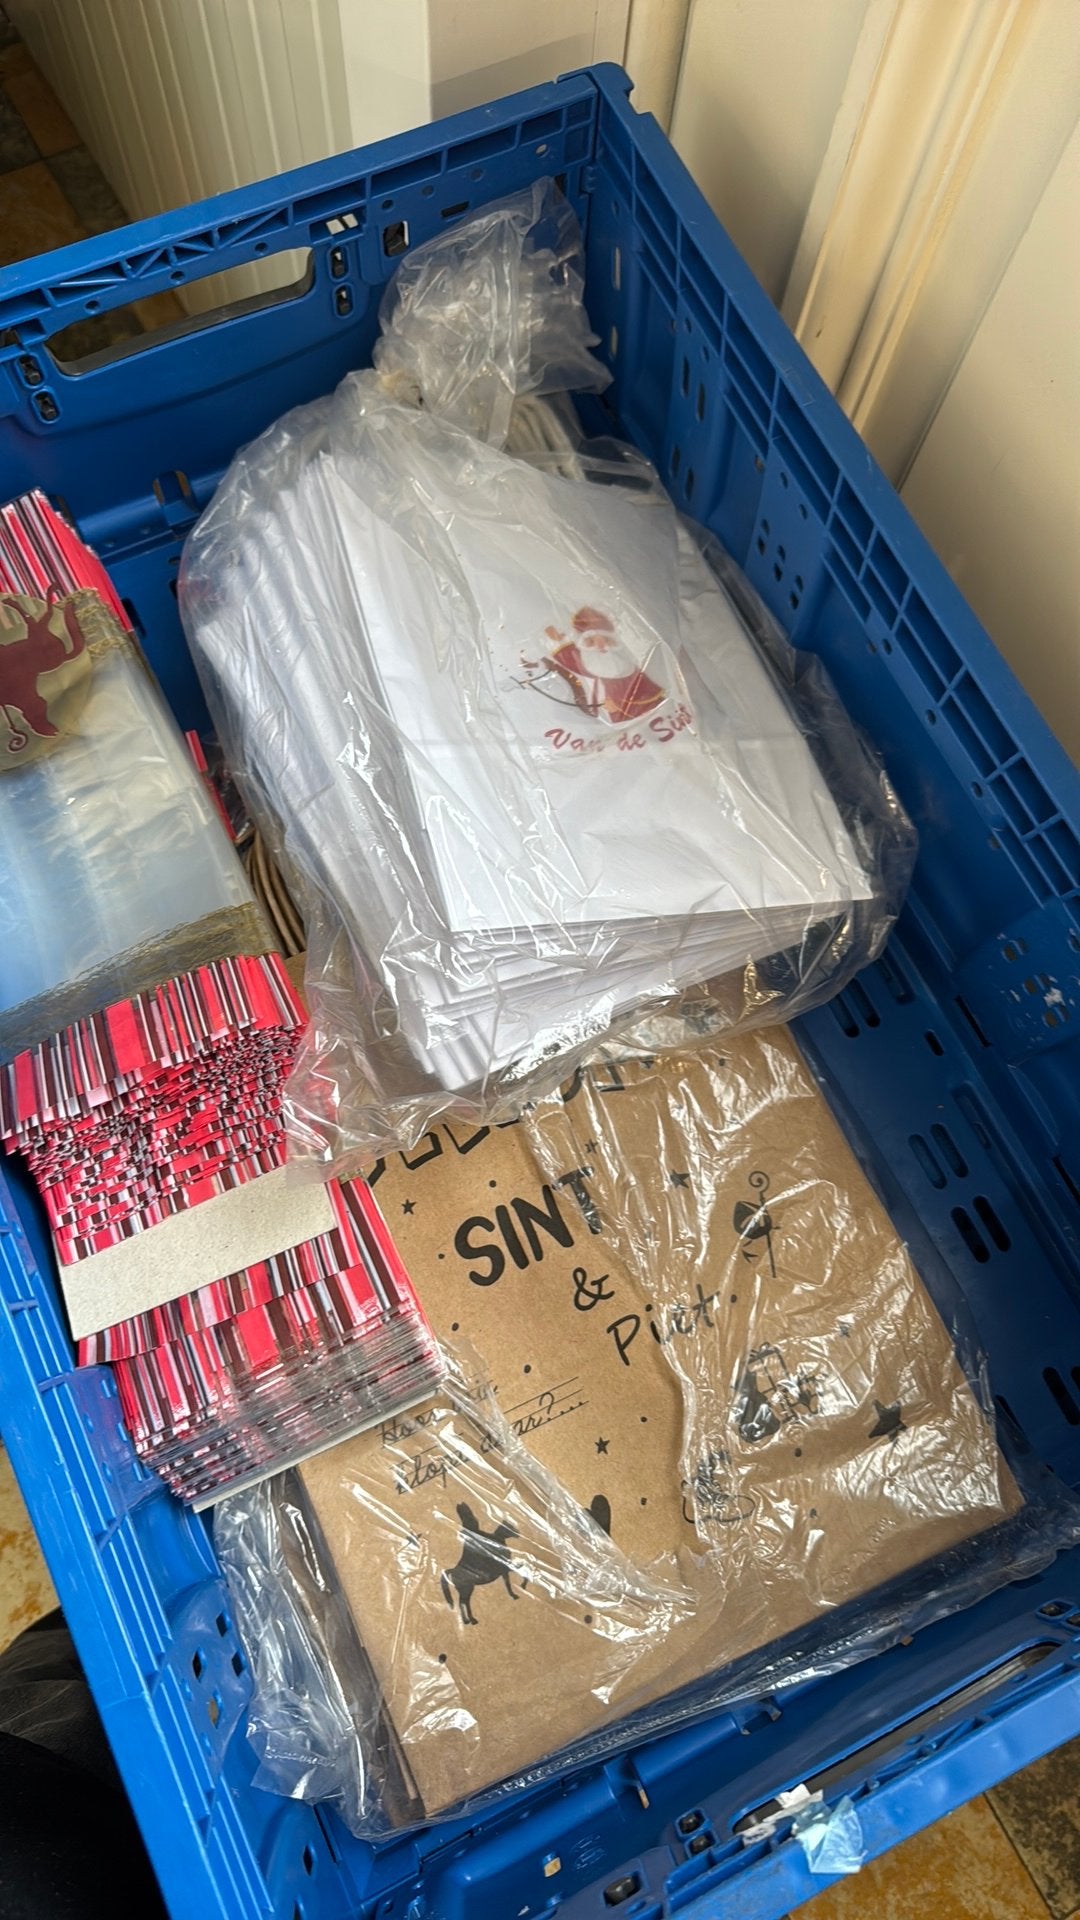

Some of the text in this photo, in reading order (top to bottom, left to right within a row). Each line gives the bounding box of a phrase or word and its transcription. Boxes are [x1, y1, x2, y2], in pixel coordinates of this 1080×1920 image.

[544, 727, 605, 753] Van
[617, 731, 647, 752] de
[453, 1165, 604, 1287] SINT
[572, 1266, 616, 1312] &
[605, 1284, 722, 1367] Piet
